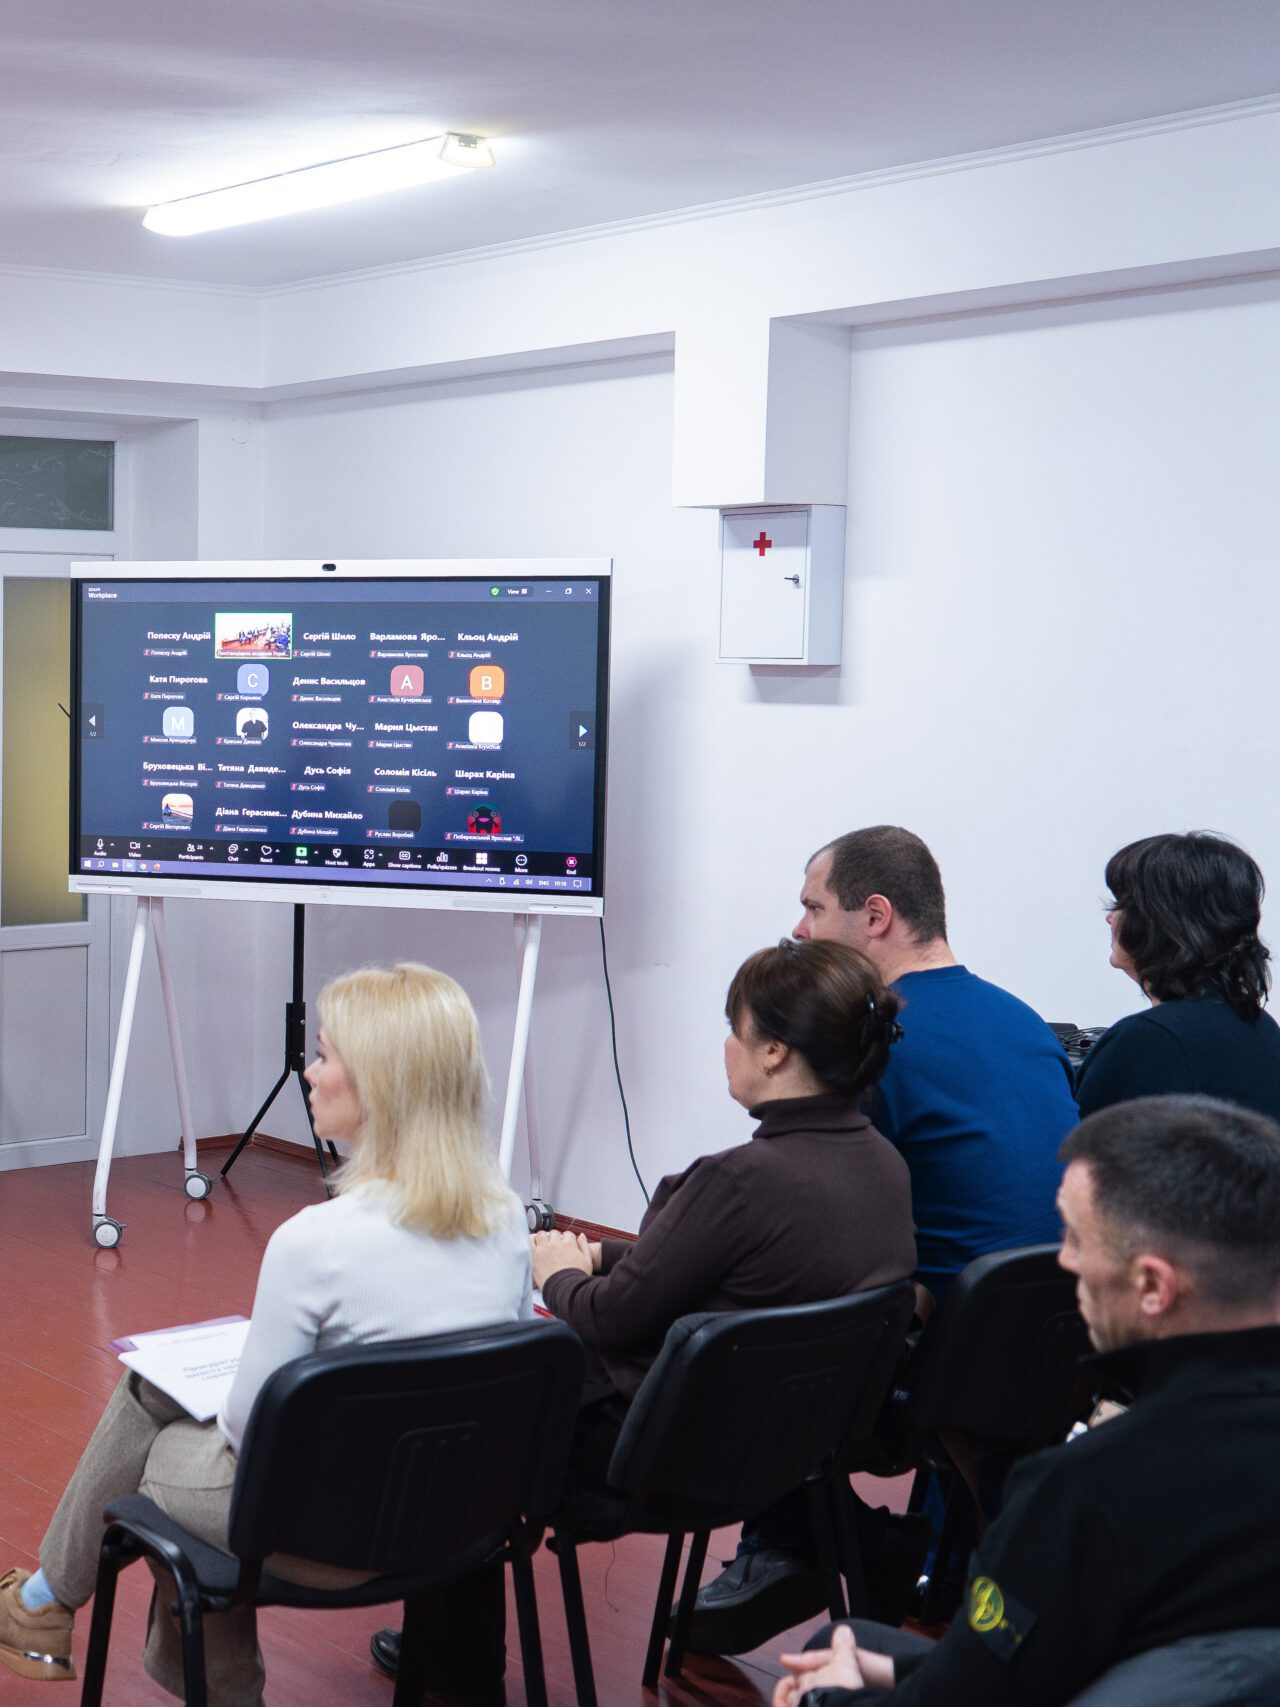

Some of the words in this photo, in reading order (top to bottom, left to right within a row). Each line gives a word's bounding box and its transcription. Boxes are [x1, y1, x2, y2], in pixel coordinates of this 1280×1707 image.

[147, 632, 181, 641] Попеску
[182, 631, 211, 641] Андрій
[303, 632, 330, 641] Сергій
[370, 633, 418, 642] Варламова
[421, 633, 446, 642] Яро...
[457, 633, 485, 643] Кльоц
[486, 633, 519, 643] Андрій
[149, 675, 168, 683] Катя
[169, 675, 208, 685] Пирогова
[292, 677, 319, 686] Денис
[320, 677, 366, 686] Васильцов
[292, 721, 342, 731] Олександра
[345, 722, 365, 732] Чу...
[374, 723, 404, 733] Мария
[405, 723, 438, 733] Цыстан
[143, 762, 194, 771] Бруховецька
[197, 763, 213, 771] Ві...
[218, 764, 245, 772] Тетяна
[247, 765, 286, 774] Давиде...
[304, 766, 325, 776] Дусь
[326, 767, 352, 776] Софія
[374, 768, 410, 776] Соломія
[411, 768, 438, 777] Кісіль
[455, 770, 484, 779] Шарах
[486, 770, 516, 780] Каріна
[216, 808, 239, 816] Діана
[242, 808, 287, 818] Герасиме...
[291, 810, 323, 819] Дубина
[324, 810, 363, 820] Михайло
